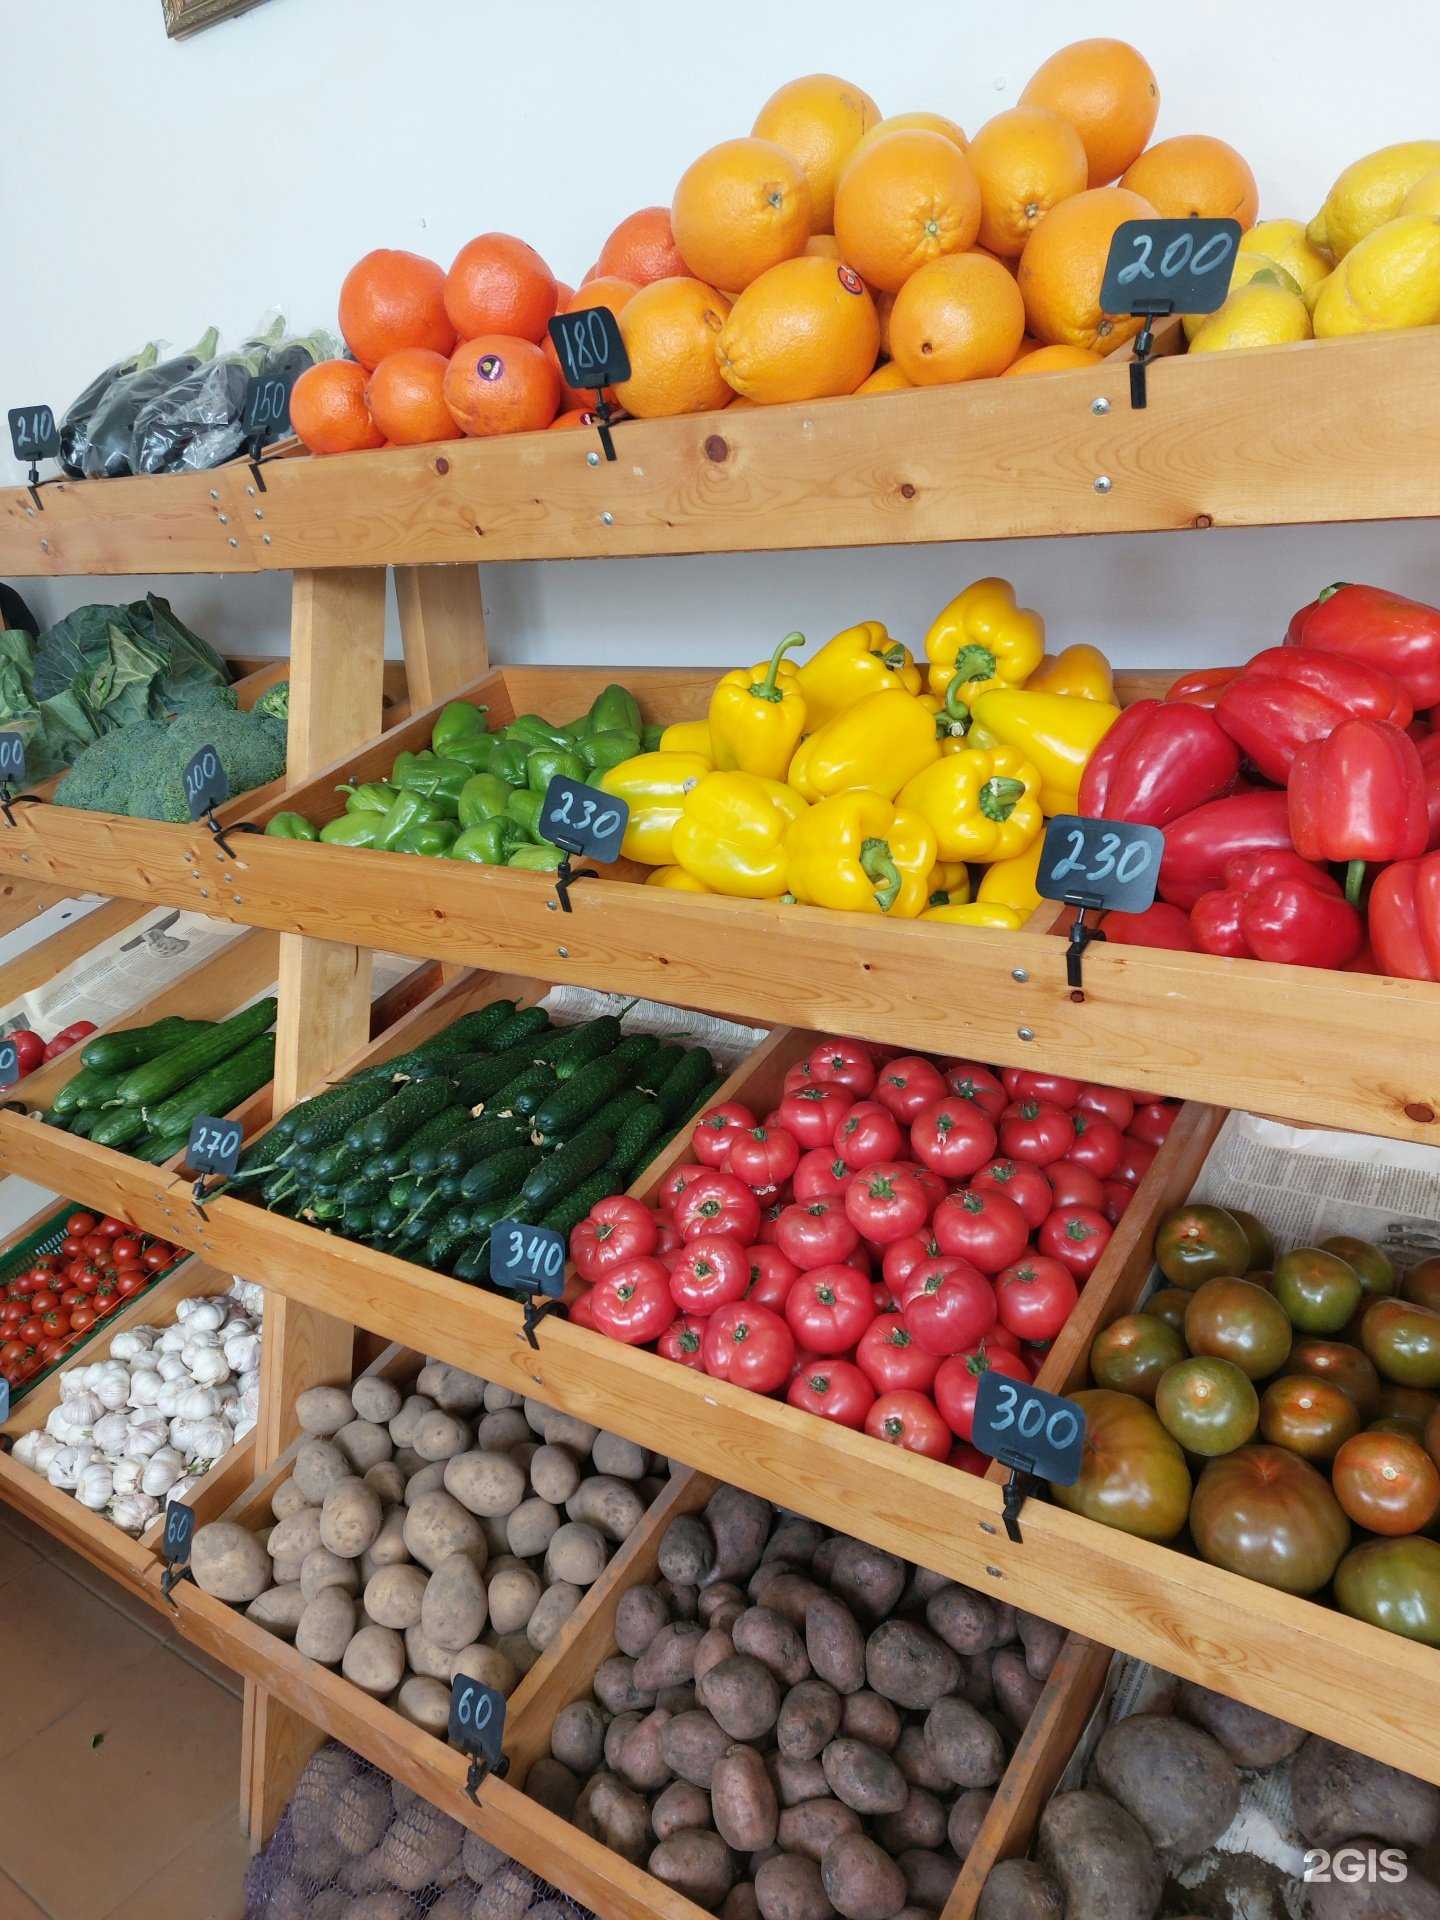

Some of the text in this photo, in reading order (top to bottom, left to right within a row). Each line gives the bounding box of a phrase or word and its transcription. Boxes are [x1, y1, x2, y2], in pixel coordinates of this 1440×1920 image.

[1118, 233, 1233, 284] 200
[562, 311, 608, 380] 180
[251, 381, 285, 425] 150
[18, 411, 53, 446] 210
[187, 753, 216, 801] 200
[550, 792, 620, 838] 230
[1051, 830, 1152, 883] 230
[192, 1127, 239, 1158] 270
[506, 1231, 563, 1276] 340
[990, 1385, 1078, 1450] 300
[168, 1512, 188, 1543] 60
[459, 1688, 492, 1729] 60
